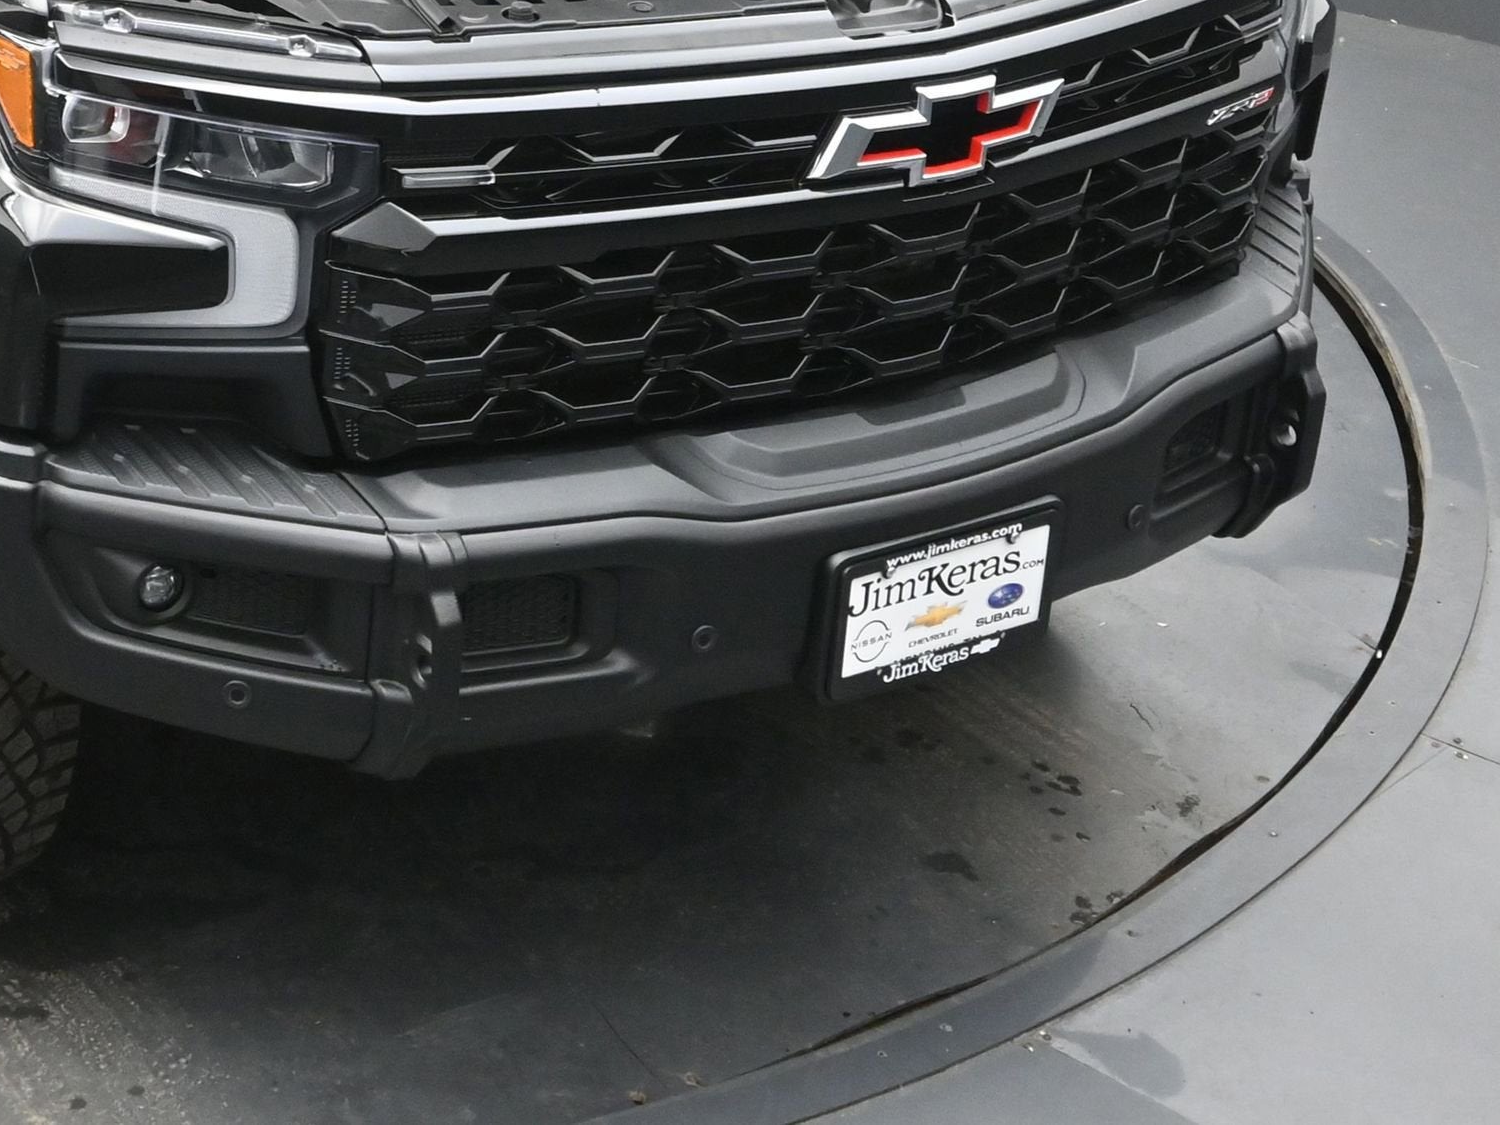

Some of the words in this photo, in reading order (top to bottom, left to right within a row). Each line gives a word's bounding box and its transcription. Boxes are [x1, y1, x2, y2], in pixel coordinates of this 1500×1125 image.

[886, 522, 1023, 568] www.jimkeras.com
[975, 606, 1031, 627] SUBARU
[851, 632, 893, 651] NISSAN
[908, 628, 958, 648] CHEVROLET
